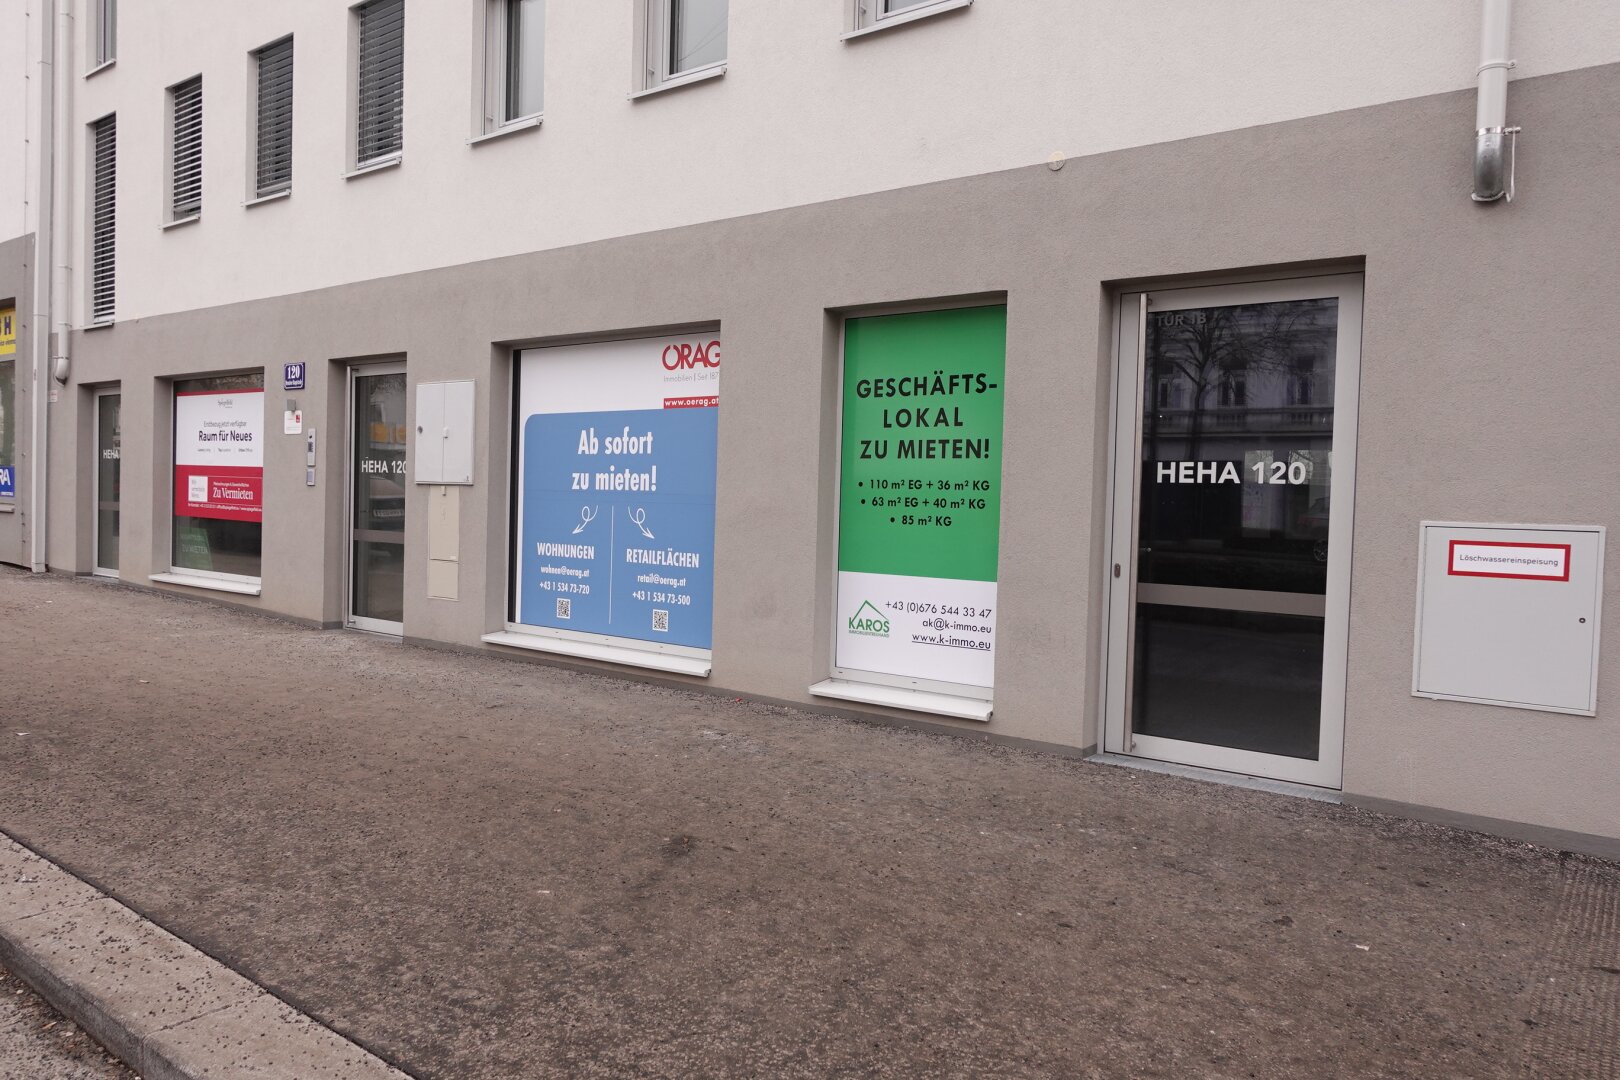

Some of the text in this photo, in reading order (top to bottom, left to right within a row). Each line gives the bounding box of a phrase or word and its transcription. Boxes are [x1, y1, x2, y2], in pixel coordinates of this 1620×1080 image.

[287, 365, 300, 379] 120
[664, 373, 693, 382] Immobilien
[698, 372, 708, 381] Seit
[856, 370, 998, 399] GESCHÄFTS-
[665, 397, 719, 407] www.oerag.at
[883, 406, 964, 429] LOKAL
[198, 430, 253, 442] Raum für Neues
[578, 426, 654, 455] Ab sofort
[103, 449, 119, 459] HEHA
[859, 438, 990, 459] ZU MIETEN!
[361, 460, 389, 474] HEHA
[1156, 461, 1307, 485] HEHA 120
[572, 465, 657, 492] zu mieten!
[870, 479, 888, 490] 110
[891, 480, 905, 490] m²
[908, 480, 922, 490] EG
[937, 480, 951, 490] 36
[954, 480, 969, 491] m²
[972, 480, 990, 491] KG
[213, 487, 221, 498] Zu
[222, 488, 253, 500] Vermieten
[871, 497, 885, 507] 63
[887, 497, 901, 507] m²
[904, 497, 919, 507] EG
[933, 498, 947, 508] 40
[950, 498, 965, 509] m²
[968, 498, 986, 510] KG
[901, 515, 952, 527] 85 m² KG
[537, 542, 595, 560] WOHNUNGEN
[626, 547, 700, 569] RETAILFLÄCHEN
[1459, 554, 1559, 567] Löschwassereinspeisung
[540, 564, 590, 579] wohnen@oerag.at
[539, 580, 590, 595] +43 1 534 73-720
[637, 574, 686, 589] retail@oerag.at
[632, 590, 691, 606] +43 1 534 73-500
[885, 600, 992, 619] +43 (0)676 544 33 47
[848, 616, 890, 634] KAROS
[922, 617, 992, 634] ak@k-immo.eu
[912, 633, 991, 650] www.k-immo.eu
